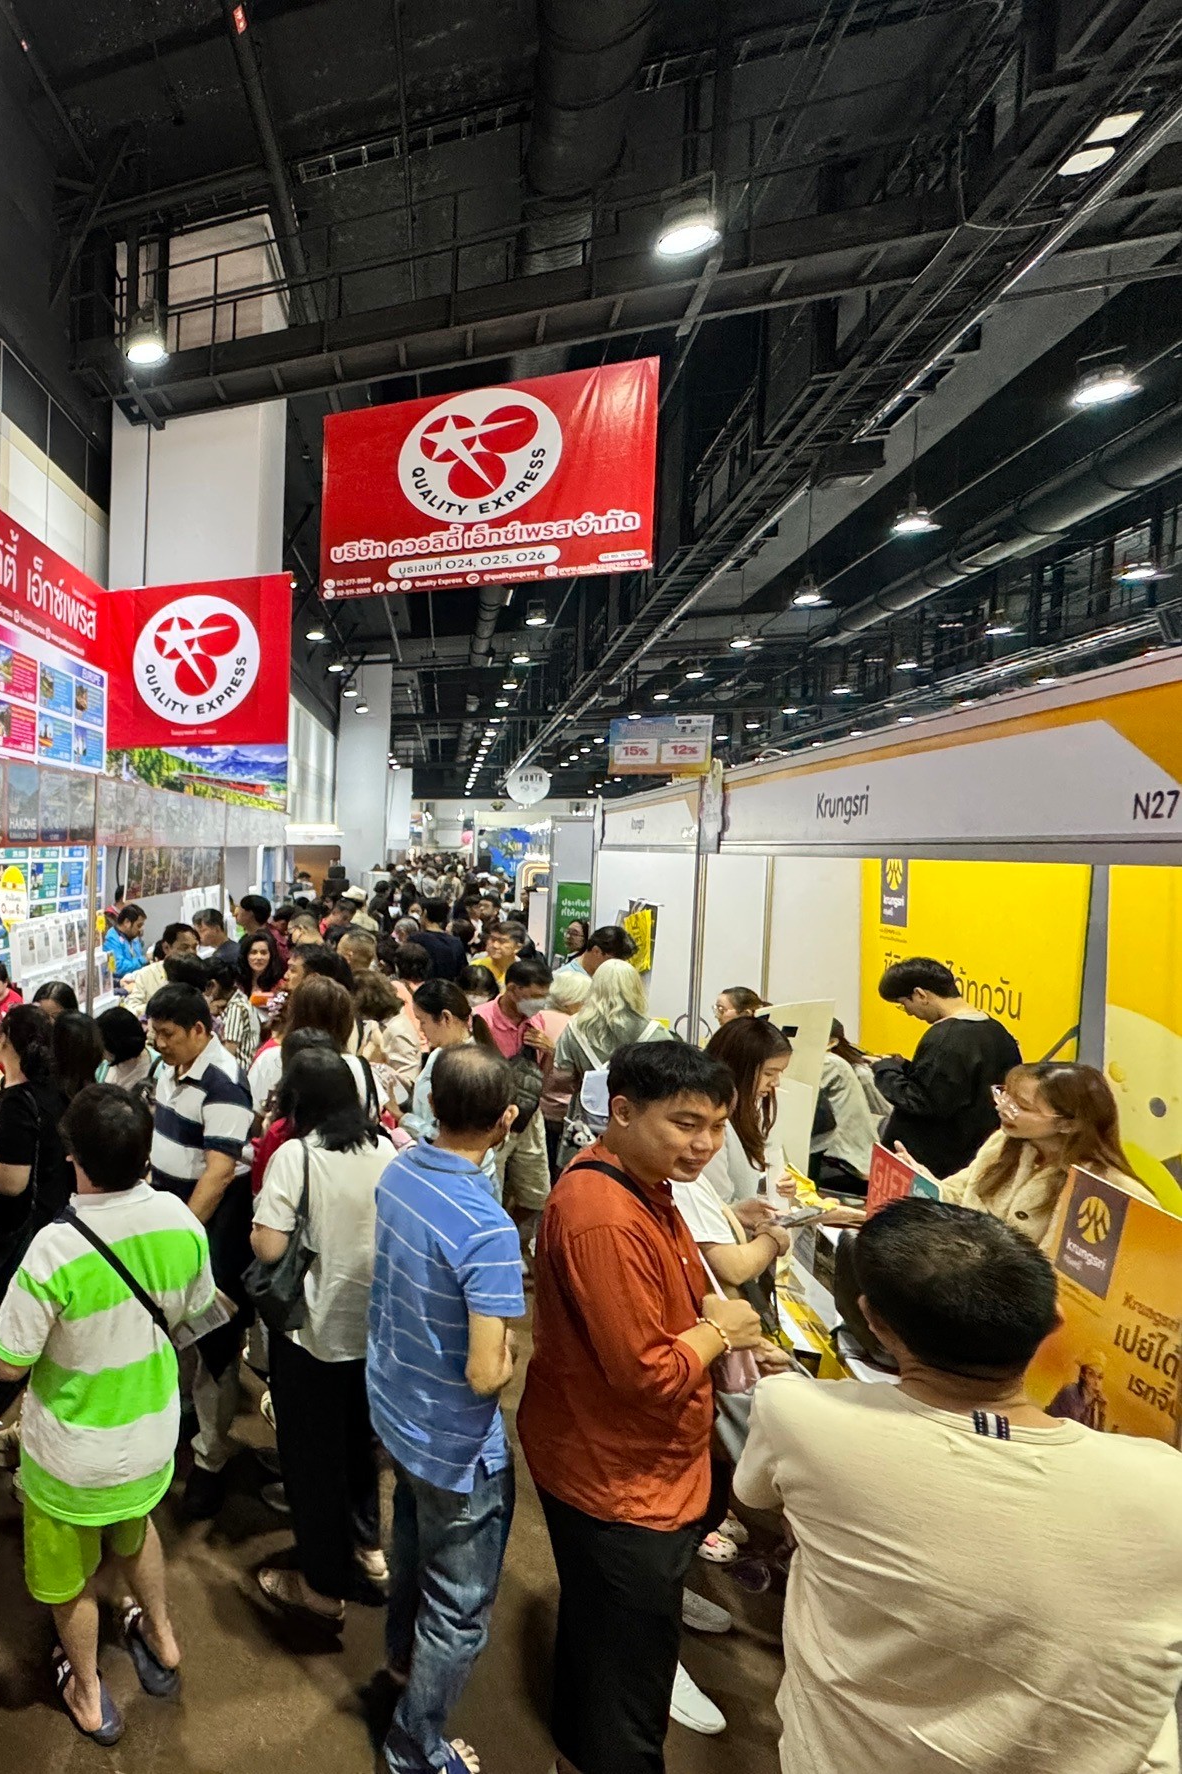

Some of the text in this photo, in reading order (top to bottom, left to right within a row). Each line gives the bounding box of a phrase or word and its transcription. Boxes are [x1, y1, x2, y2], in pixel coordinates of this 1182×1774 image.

[411, 447, 547, 517] QUALITY EXPRESS
[330, 508, 641, 563] บริษัท ควอลิตี้ เอ็กซ์เพรส จำกัด
[26, 555, 97, 641] เอ็กซ์เพรส
[145, 656, 247, 715] QUALITY EXPRESS
[622, 745, 649, 757] 15%
[671, 744, 698, 756] 12%
[816, 785, 870, 825] Krungsri
[1132, 790, 1180, 820] N27
[9, 818, 37, 830] HAKONE
[1066, 1238, 1107, 1271] krungsri
